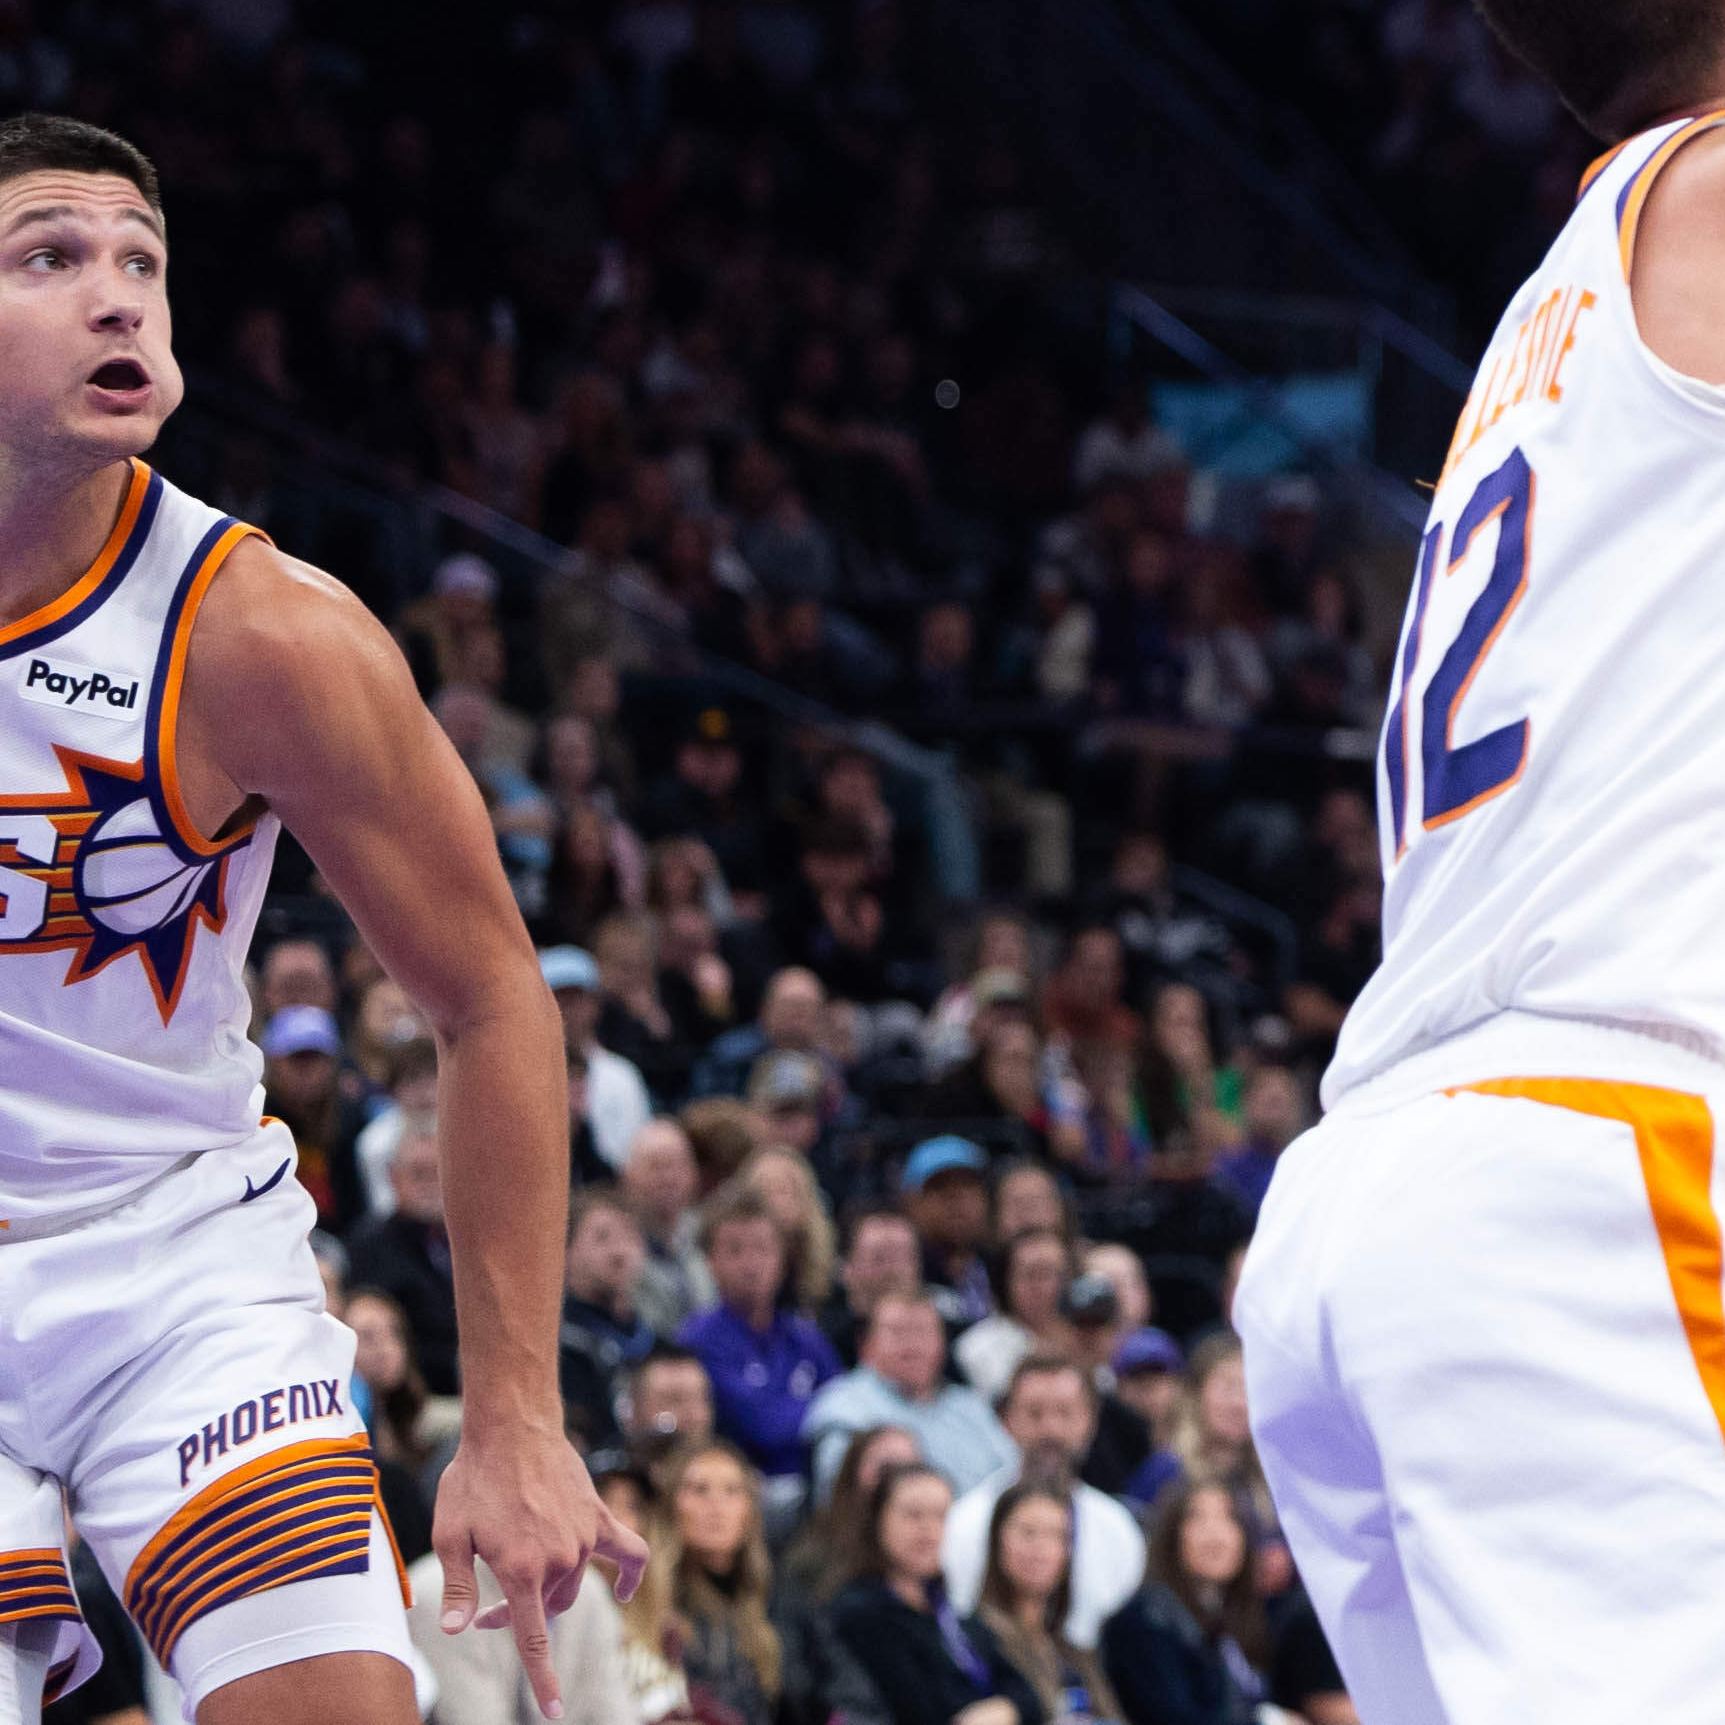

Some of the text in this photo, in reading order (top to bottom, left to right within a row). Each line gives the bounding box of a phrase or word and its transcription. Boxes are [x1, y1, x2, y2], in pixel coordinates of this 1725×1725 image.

[26, 658, 139, 711] PayPal
[1385, 444, 1537, 865] 12
[177, 1378, 346, 1489] PHOENIX
